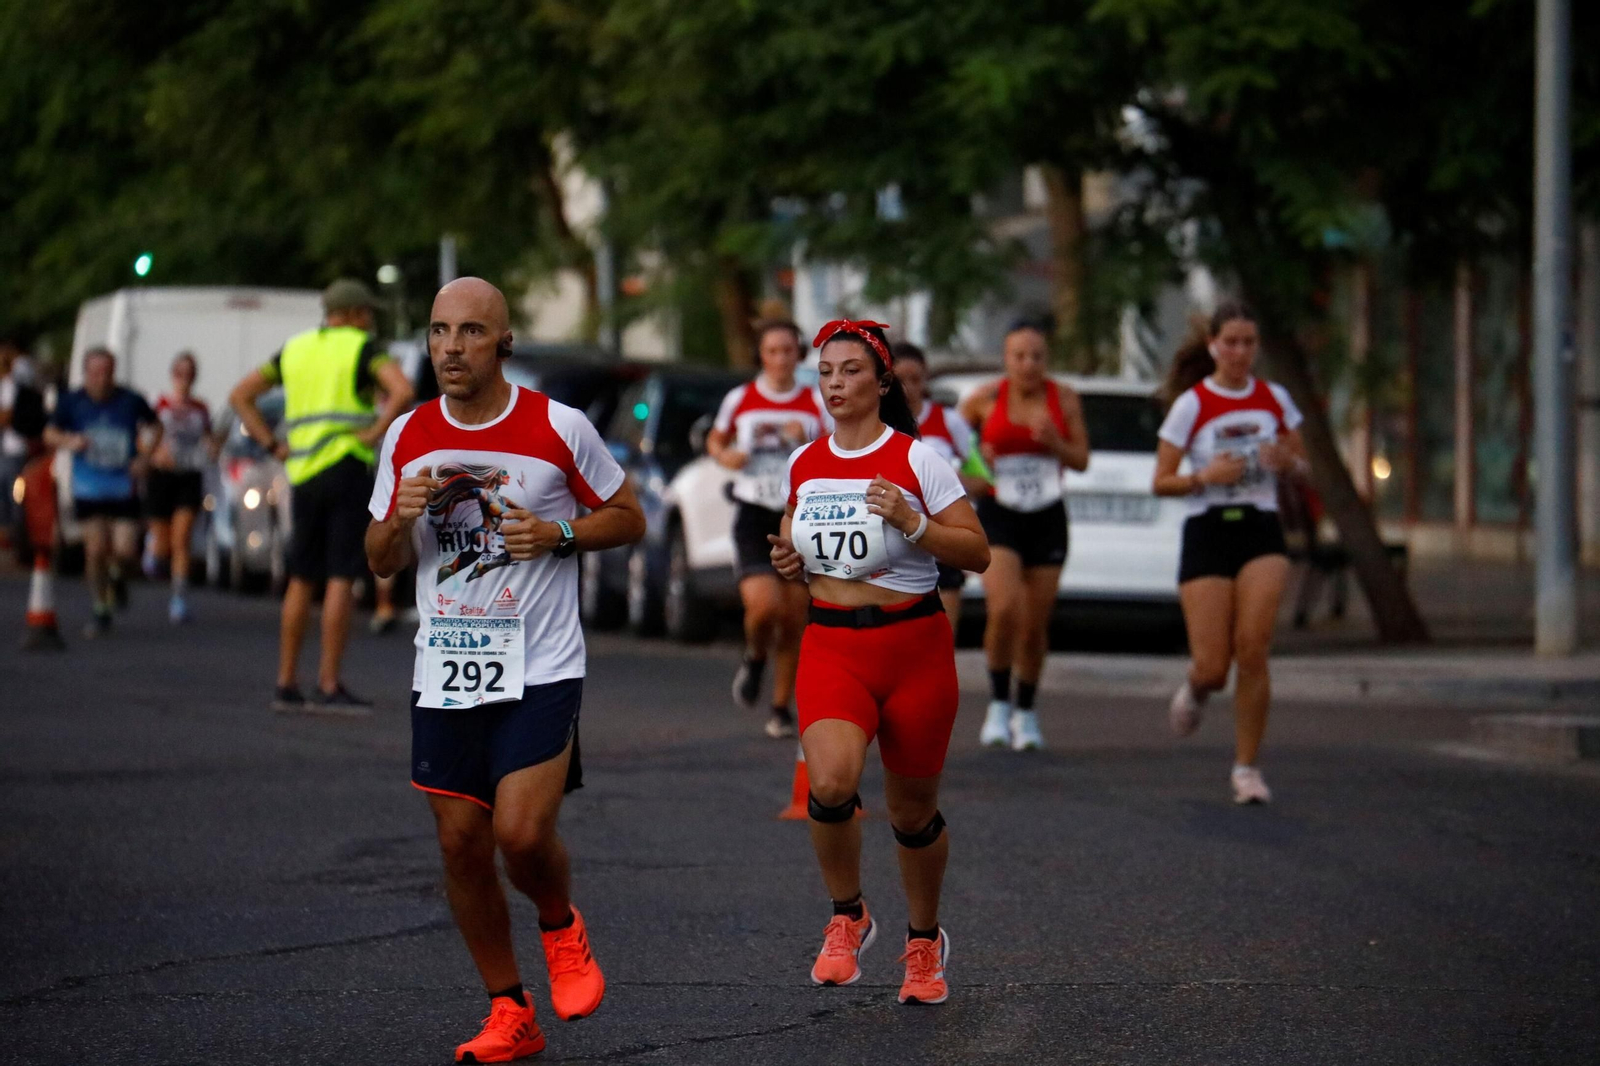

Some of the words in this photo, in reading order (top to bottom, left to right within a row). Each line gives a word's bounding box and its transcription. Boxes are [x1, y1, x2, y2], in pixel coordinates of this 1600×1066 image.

[811, 531, 868, 560] 170
[429, 630, 461, 639] 2024
[442, 660, 505, 693] 292
